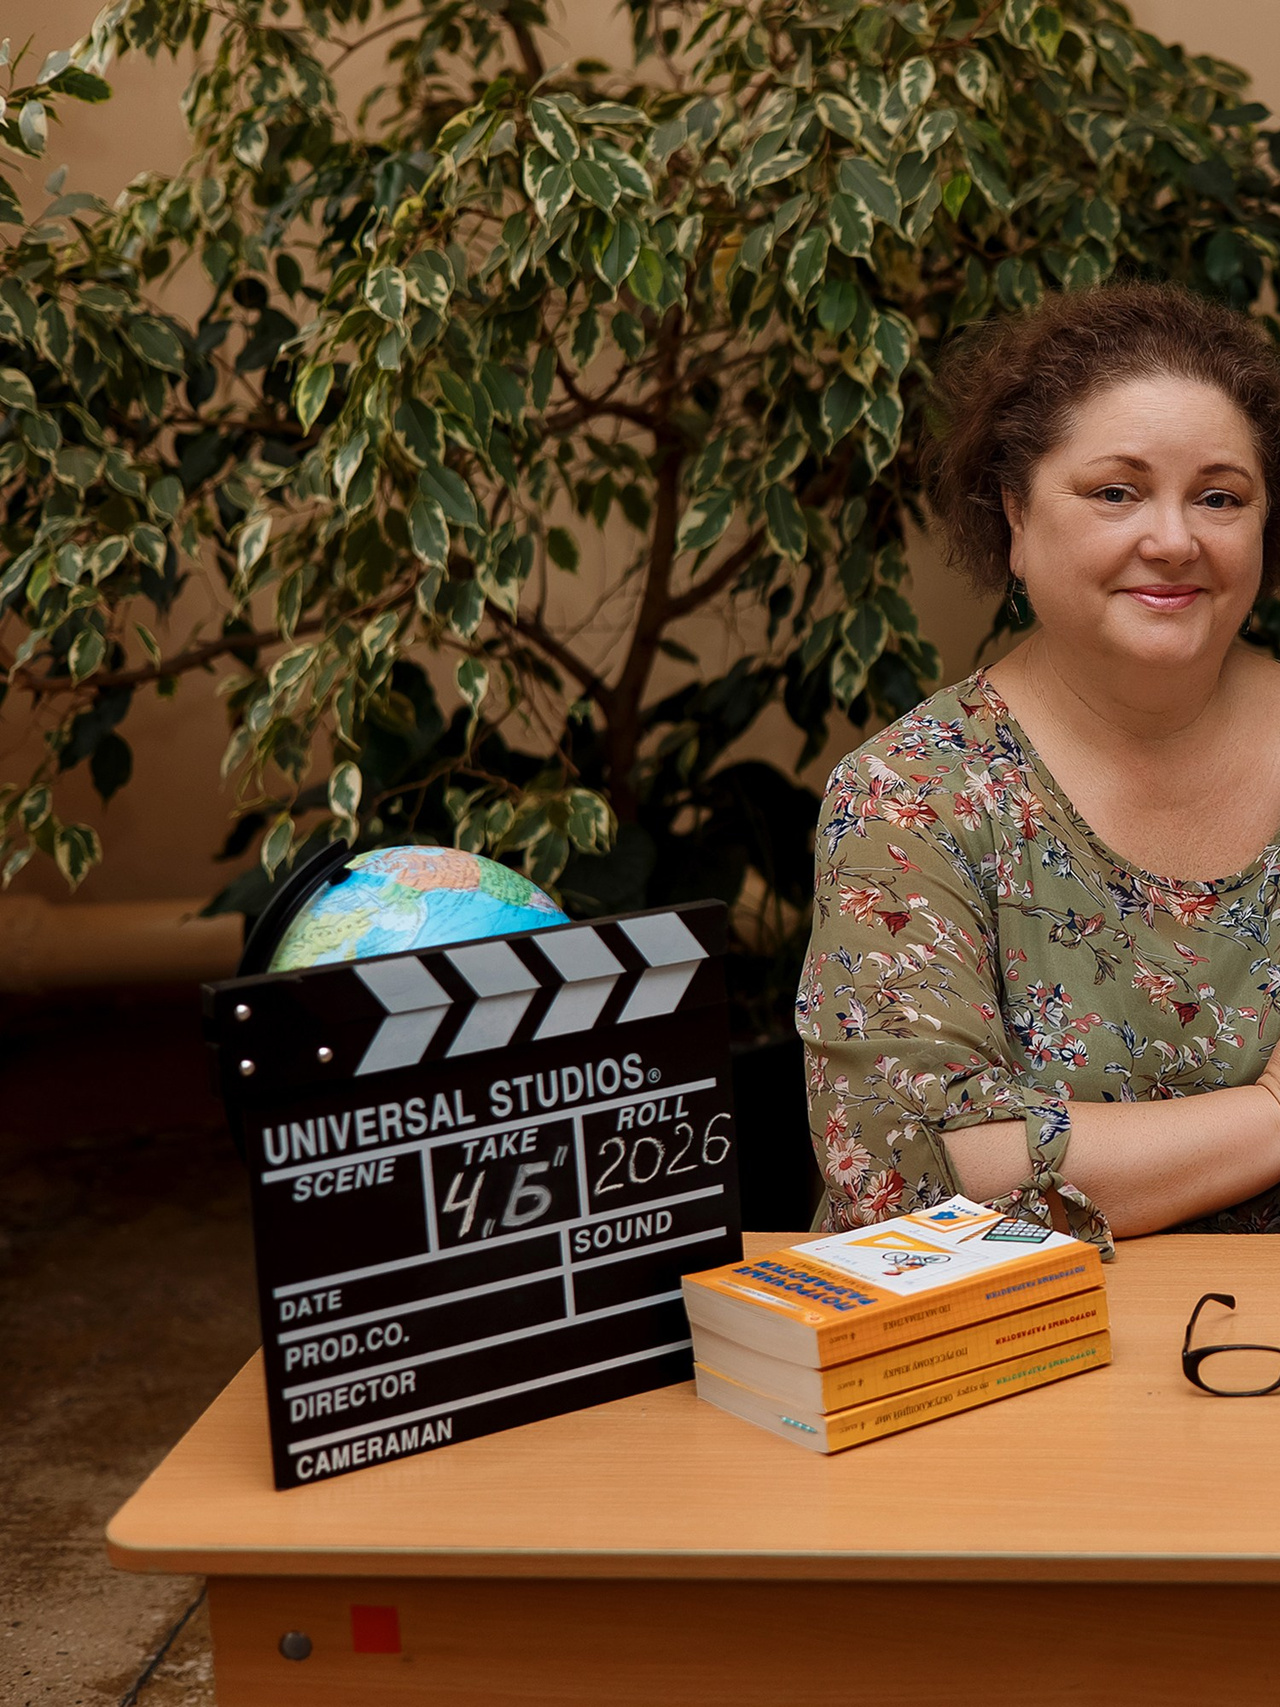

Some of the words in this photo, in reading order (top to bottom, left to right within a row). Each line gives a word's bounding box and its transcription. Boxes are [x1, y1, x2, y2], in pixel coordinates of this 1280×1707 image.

[262, 1090, 475, 1166] UNIVERSAL
[616, 1095, 689, 1132] ROLL
[462, 1128, 538, 1167] TAKE
[594, 1112, 731, 1196] 2026
[293, 1157, 396, 1202] SCENE
[574, 1210, 673, 1255] SOUND
[732, 1266, 856, 1312] ПОУРОЧНЫЕ
[753, 1260, 878, 1306] РАЗРАБОТКИ
[985, 1281, 1036, 1300] РАЗРАБОТКИ
[1036, 1265, 1086, 1286] ПОУРОЧНЫЕ
[280, 1290, 342, 1323] DATE
[882, 1308, 938, 1331] МАТЕМАТИКЕ
[939, 1304, 951, 1314] ПО
[1048, 1309, 1097, 1330] ПОУРОЧНЫЕ
[285, 1323, 411, 1371] PROD.CO.
[995, 1325, 1047, 1345] РАЗРАБОТКИ
[912, 1351, 955, 1371] РУССКОМУ
[955, 1347, 968, 1358] ПО
[1048, 1348, 1097, 1368] ПОУРОЧНЫЕ
[882, 1362, 911, 1380] ЯЗЫКУ
[996, 1363, 1047, 1385] РАЗРАБОТКИ
[290, 1371, 416, 1424] DIRECTOR
[296, 1417, 453, 1480] CAMERAMAN
